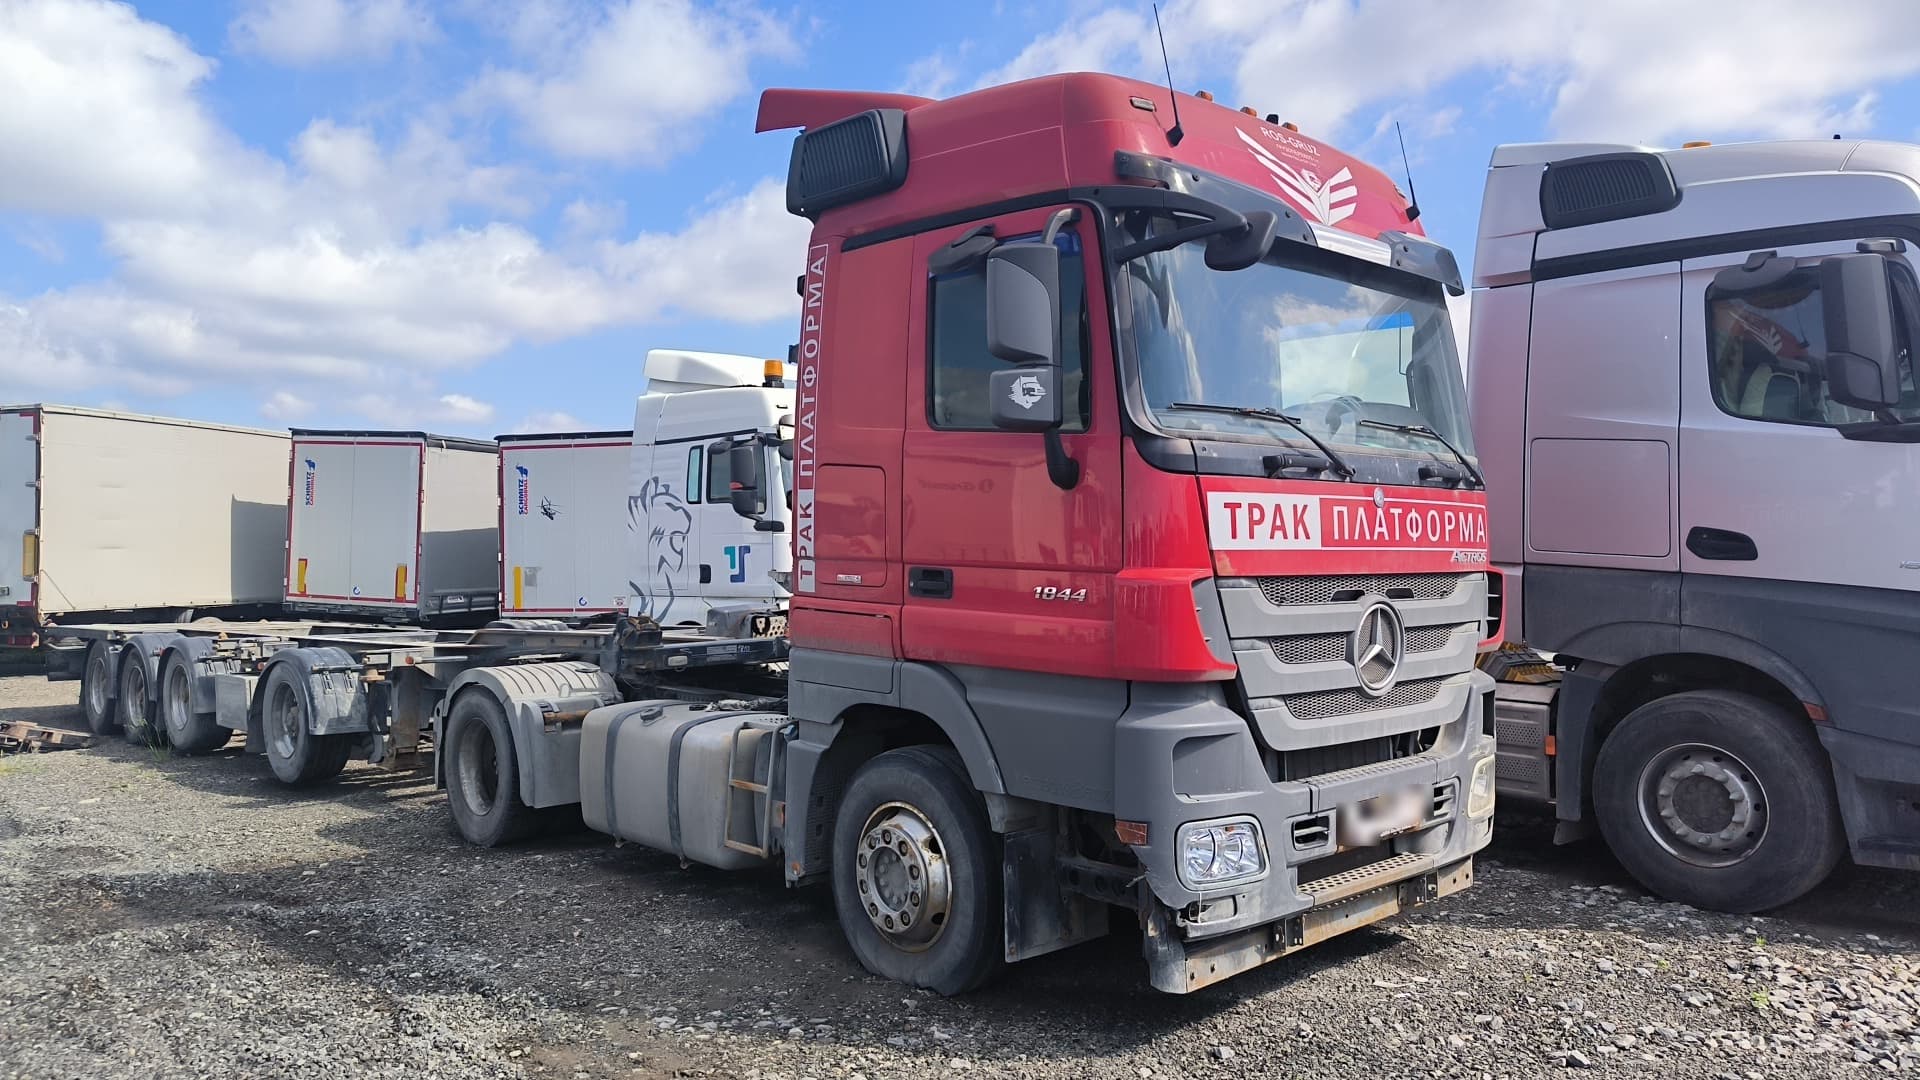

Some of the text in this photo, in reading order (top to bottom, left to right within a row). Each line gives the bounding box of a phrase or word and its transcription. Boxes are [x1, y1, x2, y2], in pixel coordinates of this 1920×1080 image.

[799, 256, 825, 580] ТРАК ПЛАТФОРМА
[1223, 502, 1487, 544] ТРАК ПЛАТФОРМА
[1033, 586, 1087, 602] 1844
